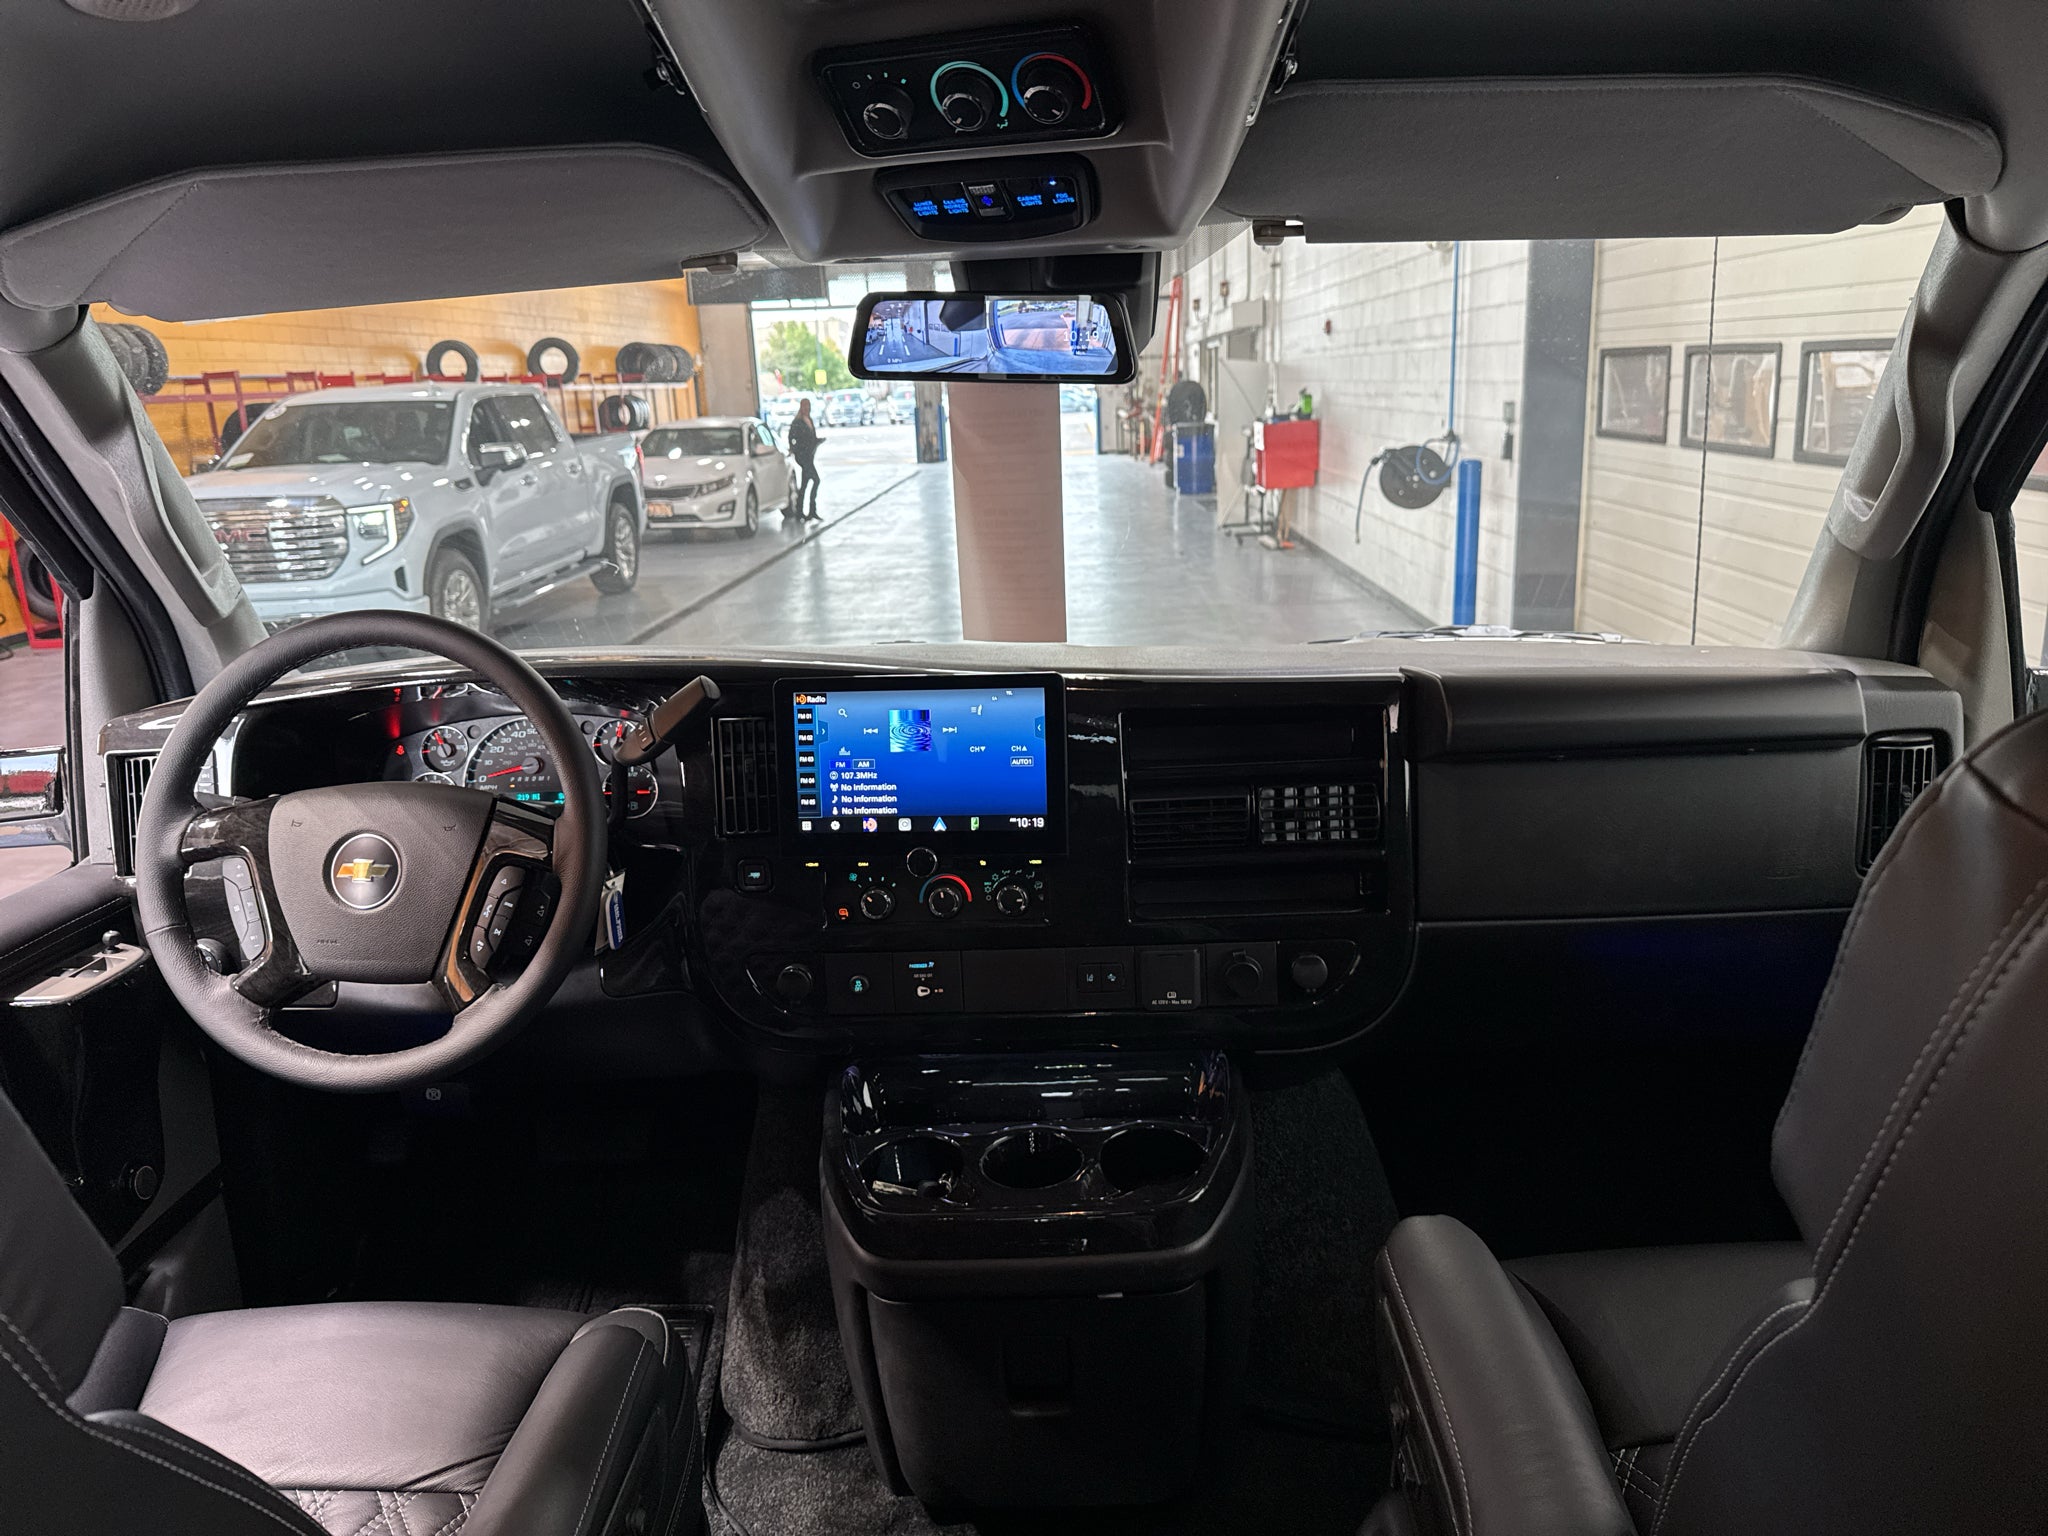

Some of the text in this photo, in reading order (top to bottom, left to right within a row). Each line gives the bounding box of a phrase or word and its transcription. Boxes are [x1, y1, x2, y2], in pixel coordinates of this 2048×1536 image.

[1063, 330, 1099, 342] 10:19
[215, 528, 268, 542] MC
[806, 695, 827, 704] Radio
[510, 730, 527, 738] 40
[489, 746, 505, 754] 20
[835, 761, 846, 769] FM
[1011, 758, 1032, 766] AUTO1
[478, 775, 487, 783] 0
[840, 771, 878, 780] 107.3MHz
[840, 783, 897, 792] No Information
[841, 795, 898, 803] No Information
[841, 807, 853, 815] No
[1016, 817, 1045, 828] 10:19
